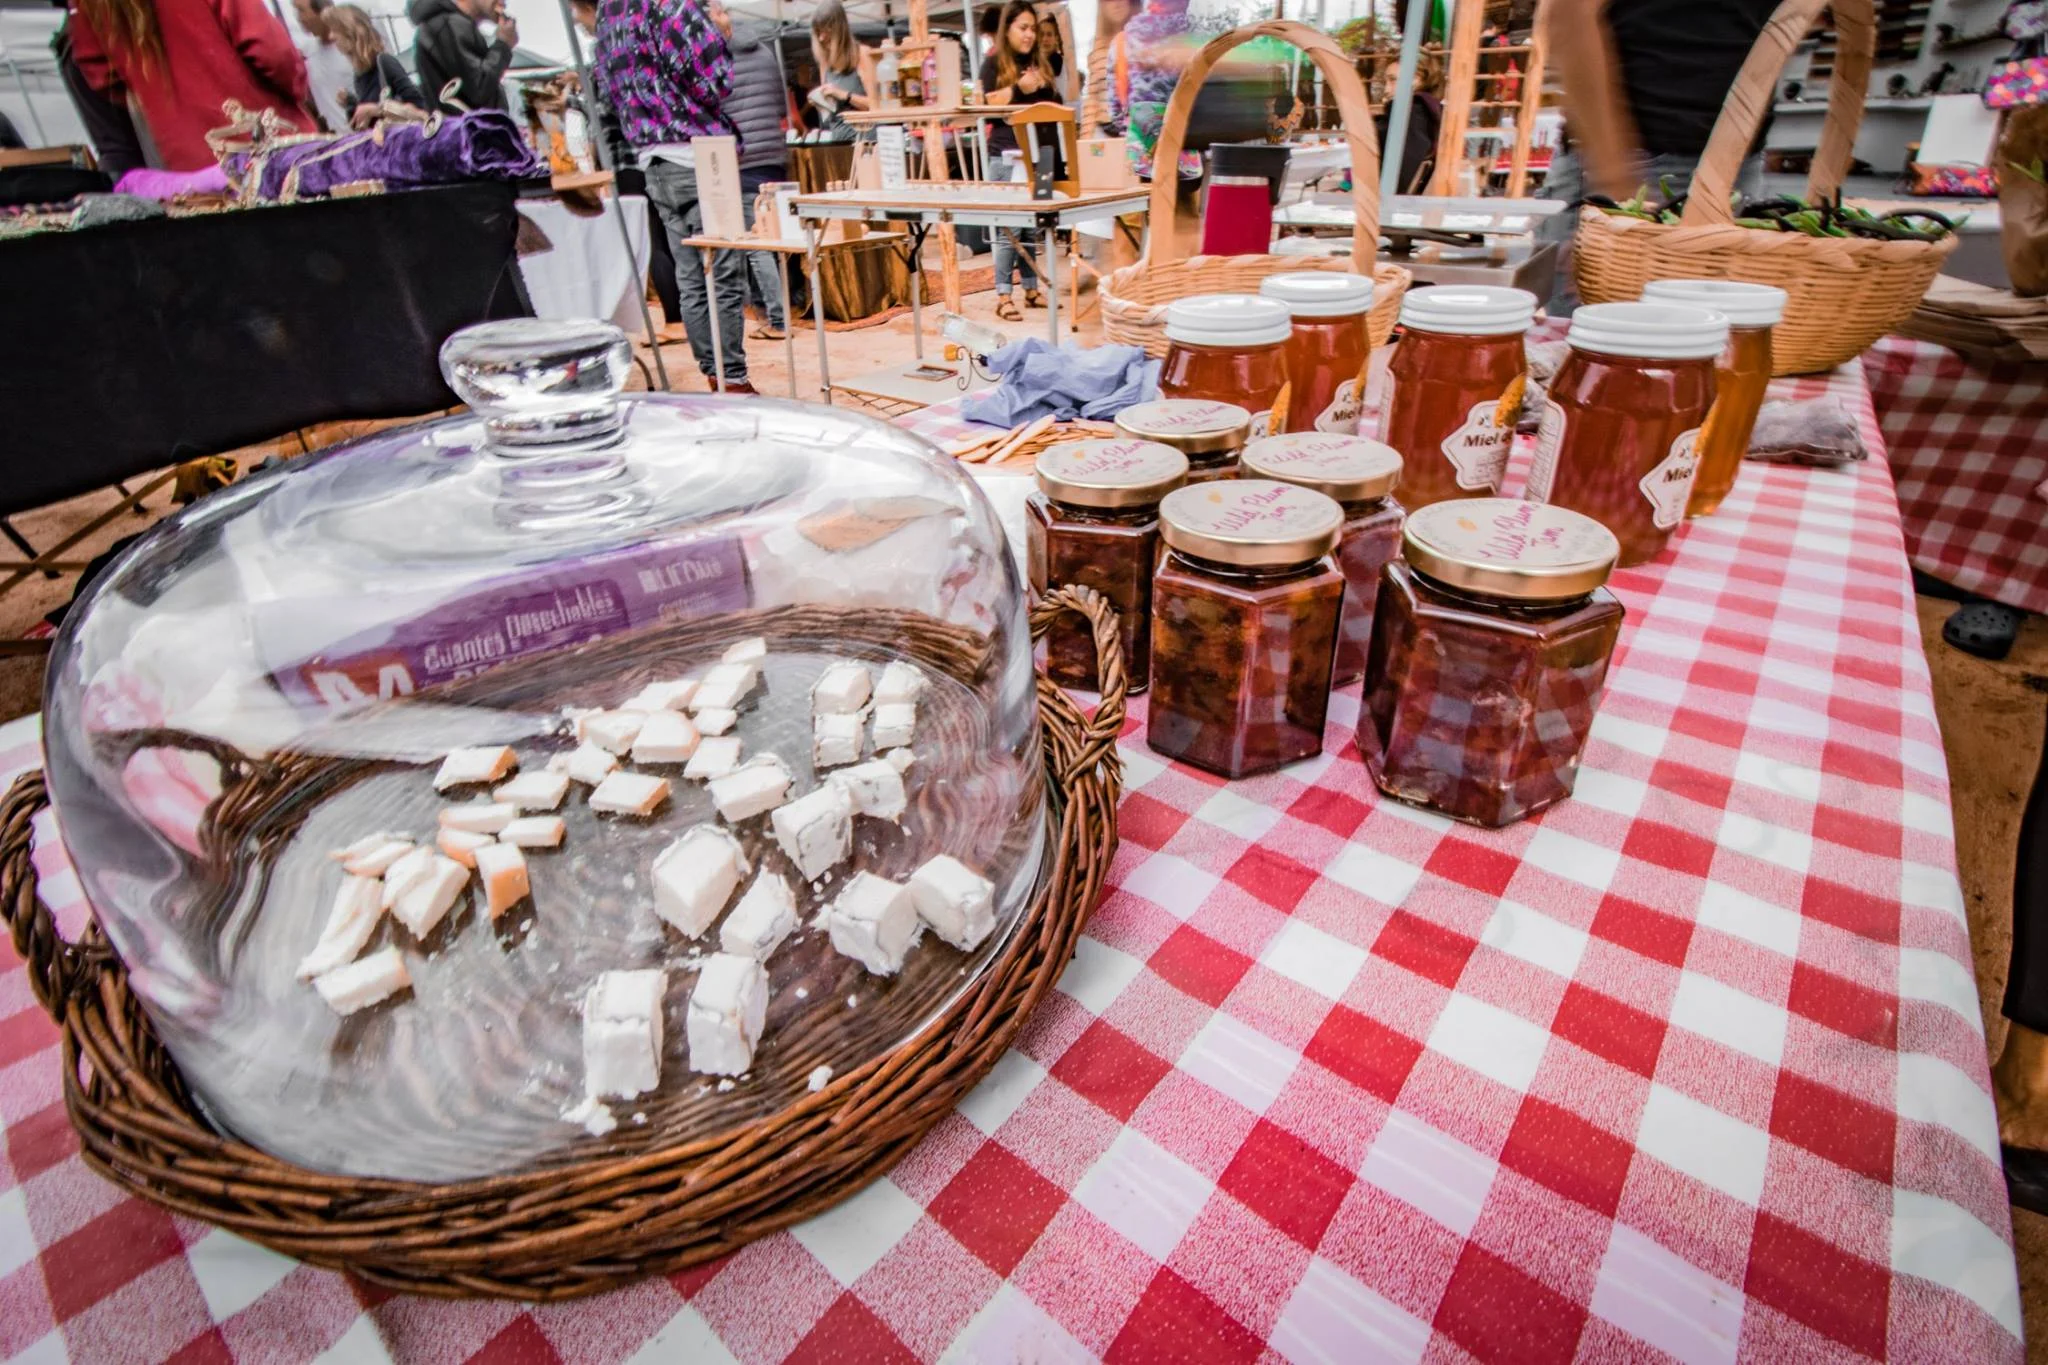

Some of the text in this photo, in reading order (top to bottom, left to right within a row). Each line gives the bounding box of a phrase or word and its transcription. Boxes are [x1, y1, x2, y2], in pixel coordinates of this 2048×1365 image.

[1261, 439, 1365, 464] Wild Plum
[1463, 432, 1499, 447] Miel
[1062, 441, 1154, 476] Wild Plum
[1212, 486, 1292, 531] Wild Plum
[1260, 505, 1297, 522] Jam
[1493, 504, 1540, 531] Plum
[1479, 529, 1528, 560] Wild
[1530, 527, 1565, 549] Jam
[424, 631, 506, 672] Guantes
[505, 586, 616, 640] Desechables
